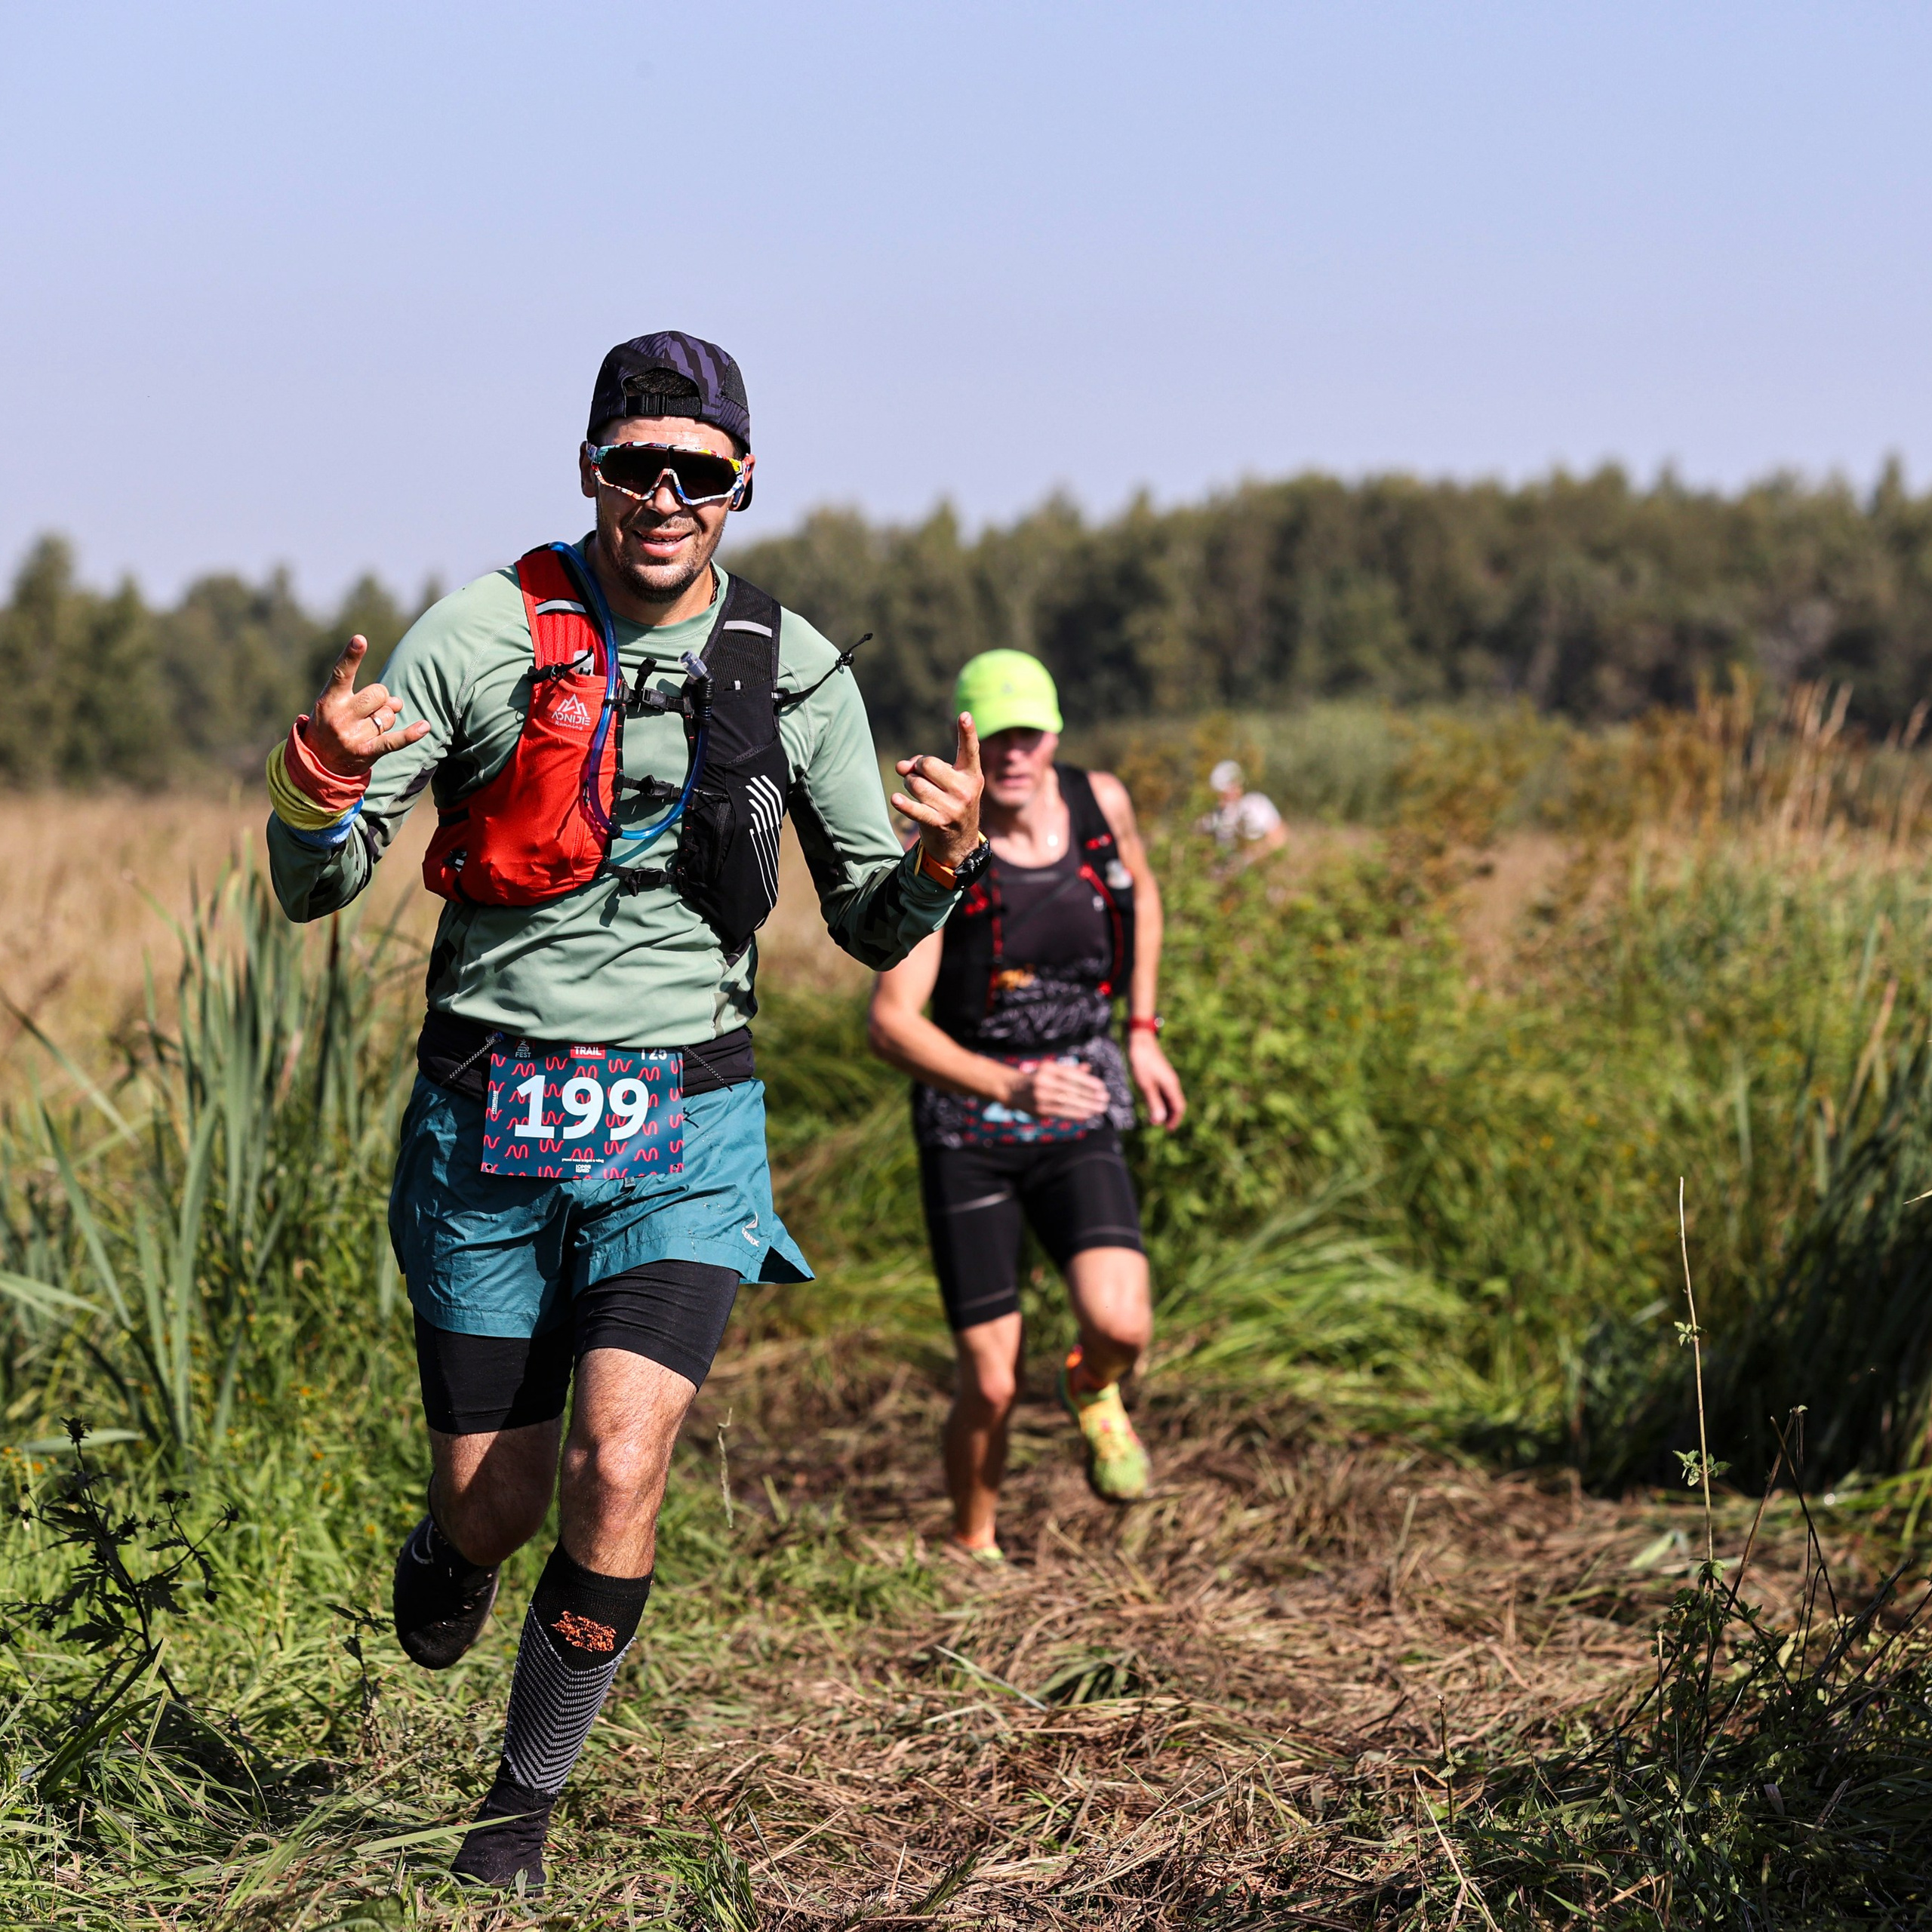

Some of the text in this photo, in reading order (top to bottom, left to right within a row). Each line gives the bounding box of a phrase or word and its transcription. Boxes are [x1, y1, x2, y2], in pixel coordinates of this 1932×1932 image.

[552, 711, 591, 725] AONIJE
[555, 720, 583, 731] Running
[574, 1046, 602, 1056] TRAIL
[515, 1075, 649, 1140] 199
